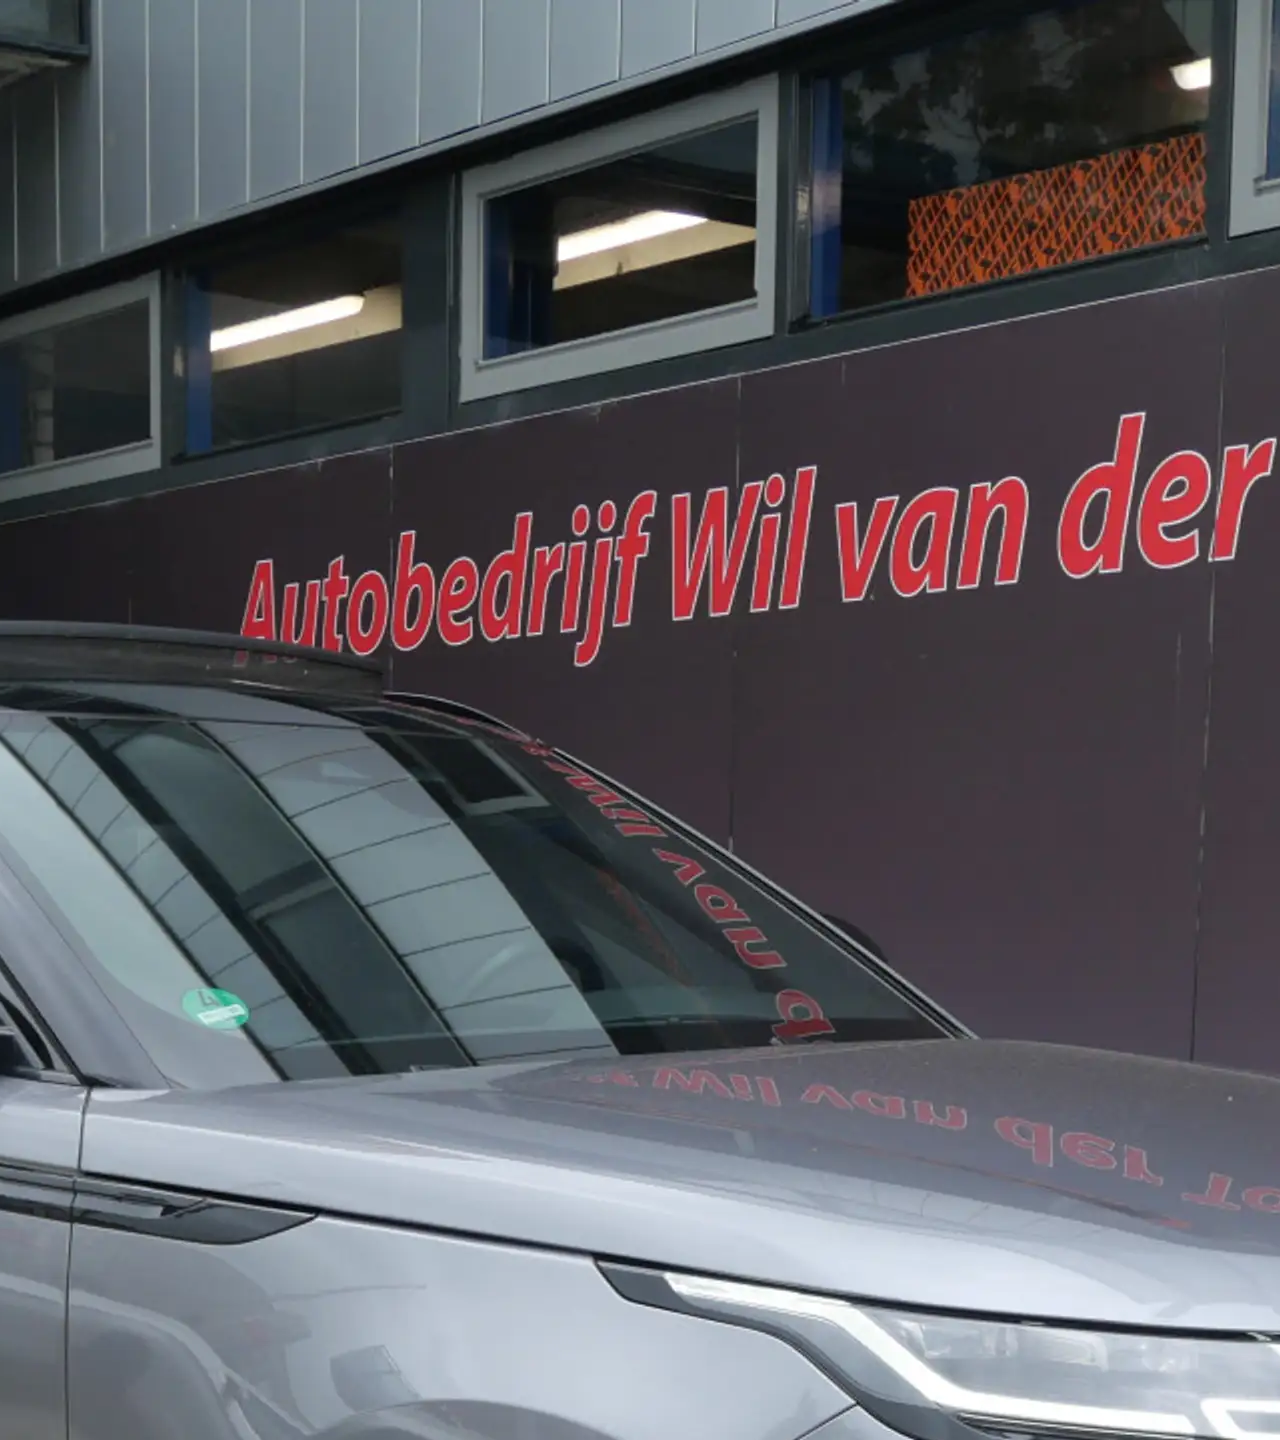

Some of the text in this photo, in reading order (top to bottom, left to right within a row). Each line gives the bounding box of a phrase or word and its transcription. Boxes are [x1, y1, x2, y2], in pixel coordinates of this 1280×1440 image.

[240, 488, 657, 667] Autobedrijf
[669, 465, 817, 622] Wil
[834, 474, 1030, 602] van
[1056, 412, 1277, 579] der
